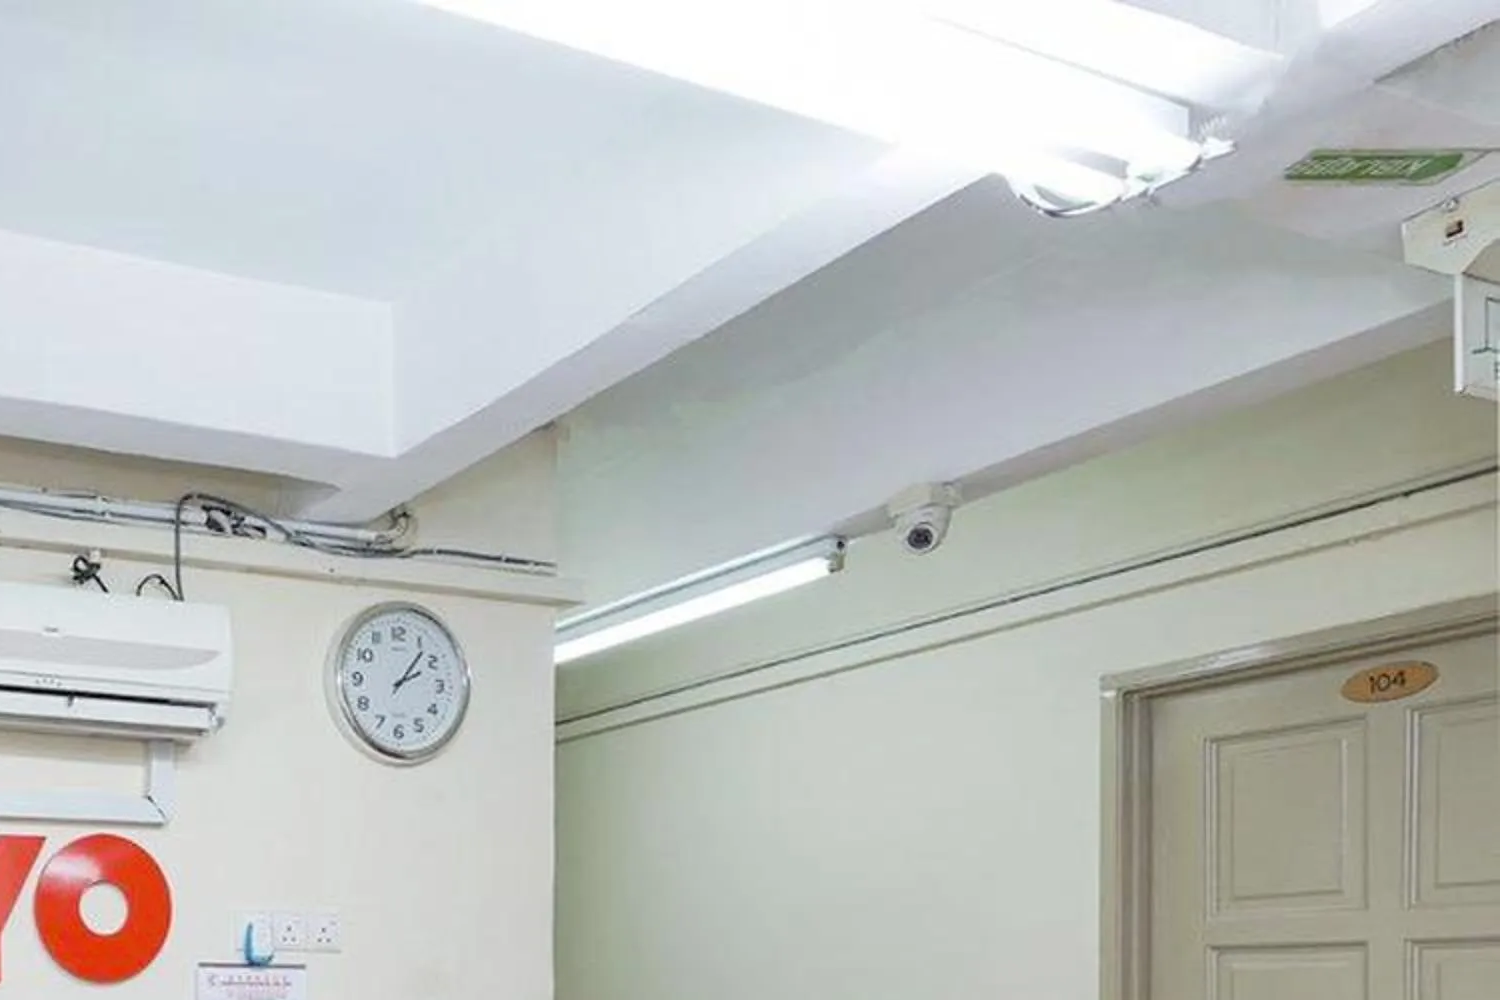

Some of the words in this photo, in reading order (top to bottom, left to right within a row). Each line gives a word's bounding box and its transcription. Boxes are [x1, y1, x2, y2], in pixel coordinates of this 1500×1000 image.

[391, 626, 406, 642] 12
[356, 648, 373, 662] 10
[428, 655, 439, 670] 2
[351, 671, 363, 686] 9
[1368, 668, 1407, 694] 104
[435, 679, 445, 694] 3
[357, 696, 370, 711] 8
[427, 703, 438, 715] 4
[375, 714, 386, 728] 7
[413, 718, 425, 733] 5
[393, 724, 405, 738] 6
